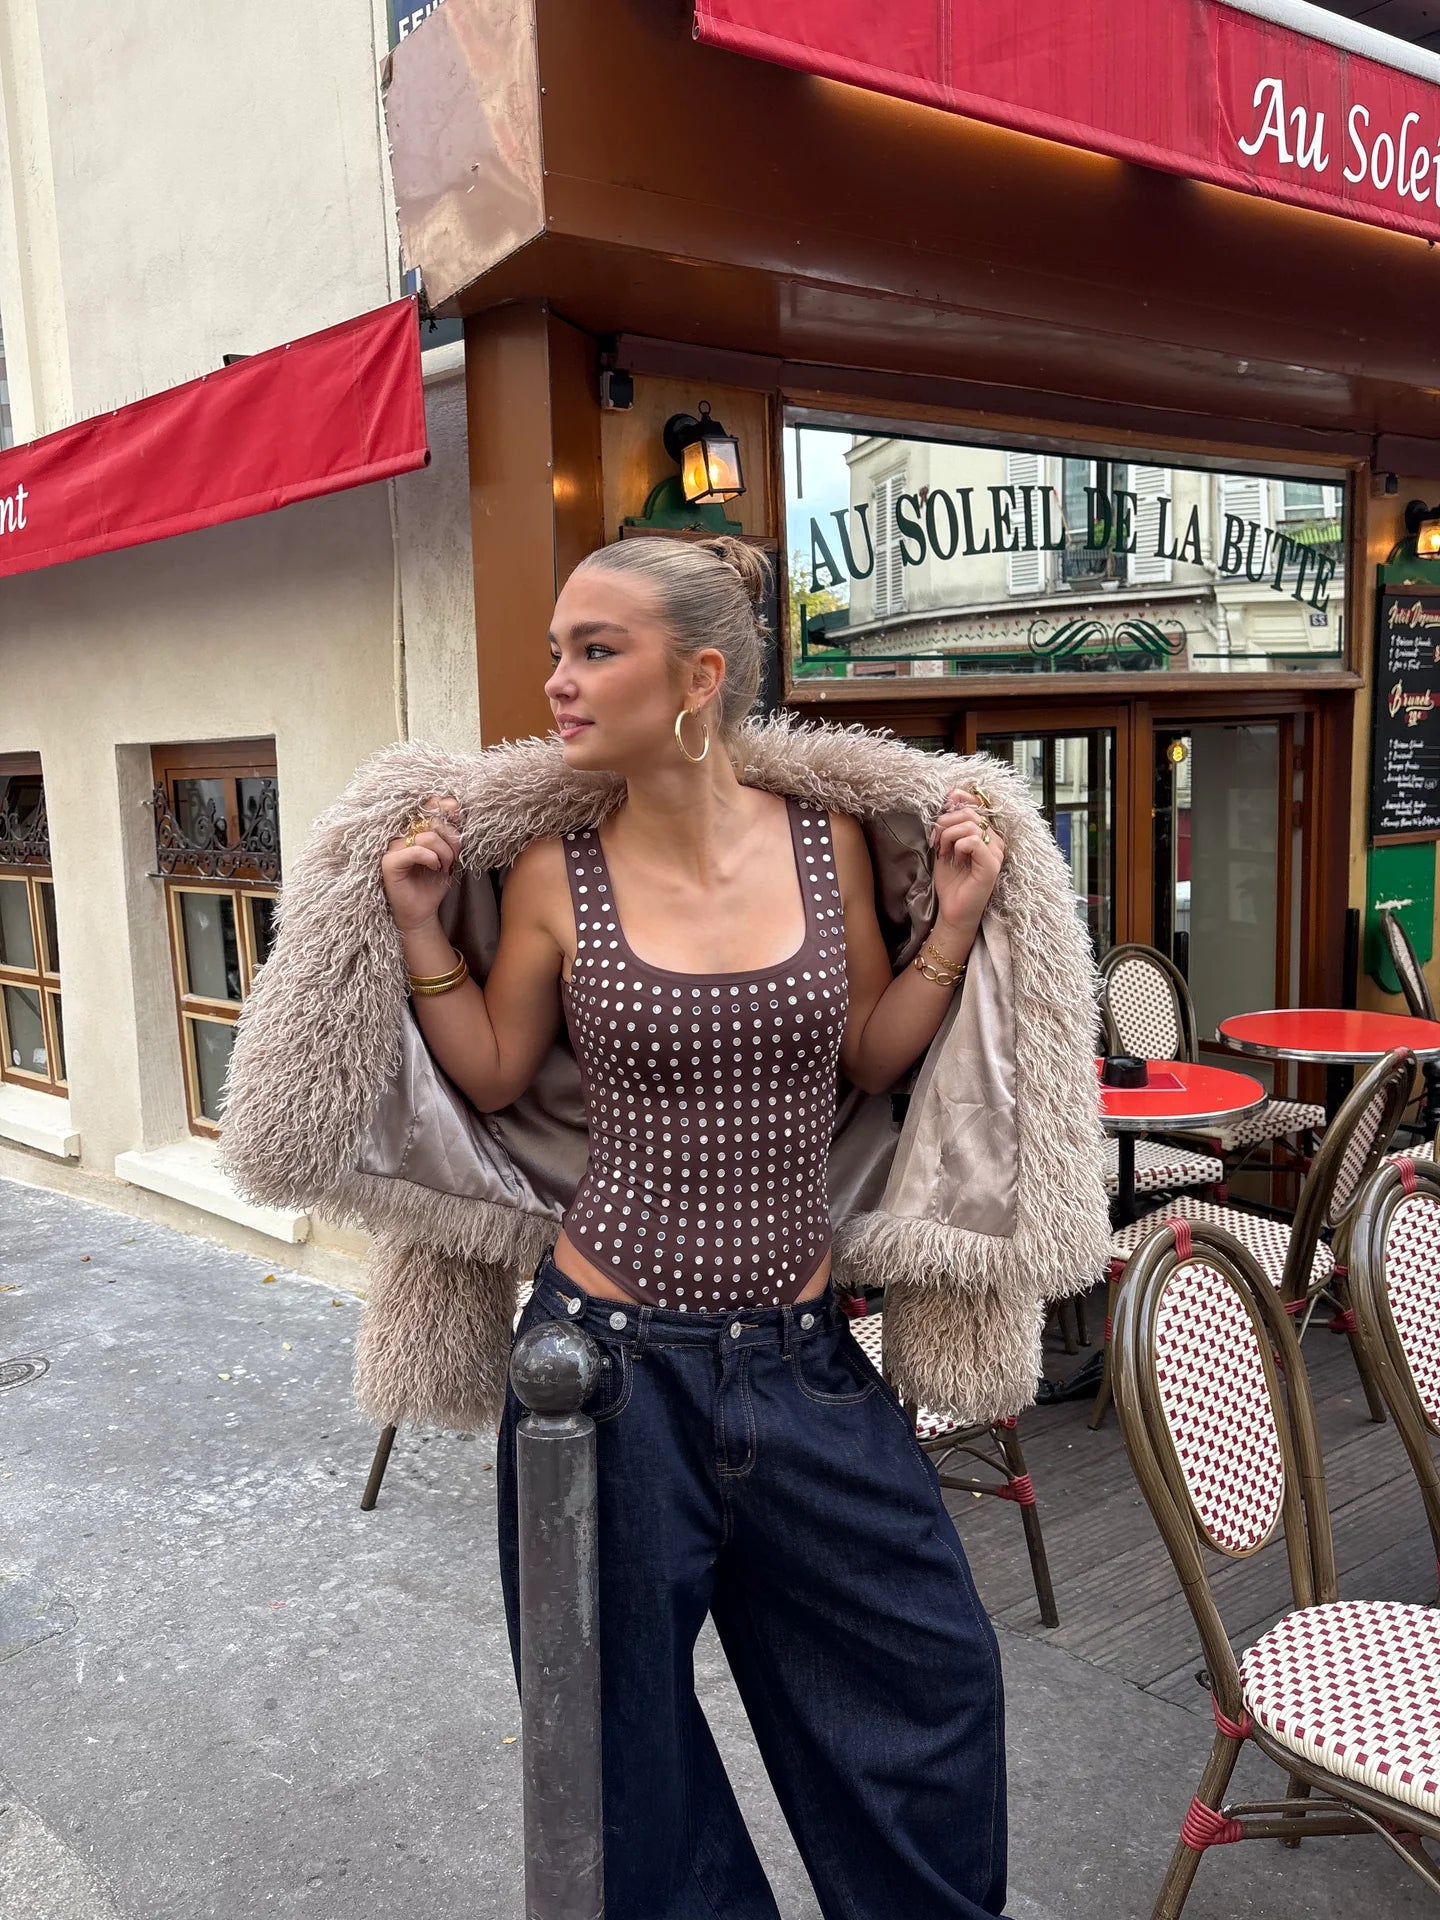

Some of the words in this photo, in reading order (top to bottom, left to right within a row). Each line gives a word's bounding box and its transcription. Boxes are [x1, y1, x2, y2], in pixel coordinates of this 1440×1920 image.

[1238, 78, 1329, 172] Au
[809, 503, 875, 593] AU
[895, 485, 1066, 567] SOLEIL
[1083, 487, 1138, 554] DE
[1154, 497, 1204, 566] LA
[1218, 513, 1336, 612] BUTTE
